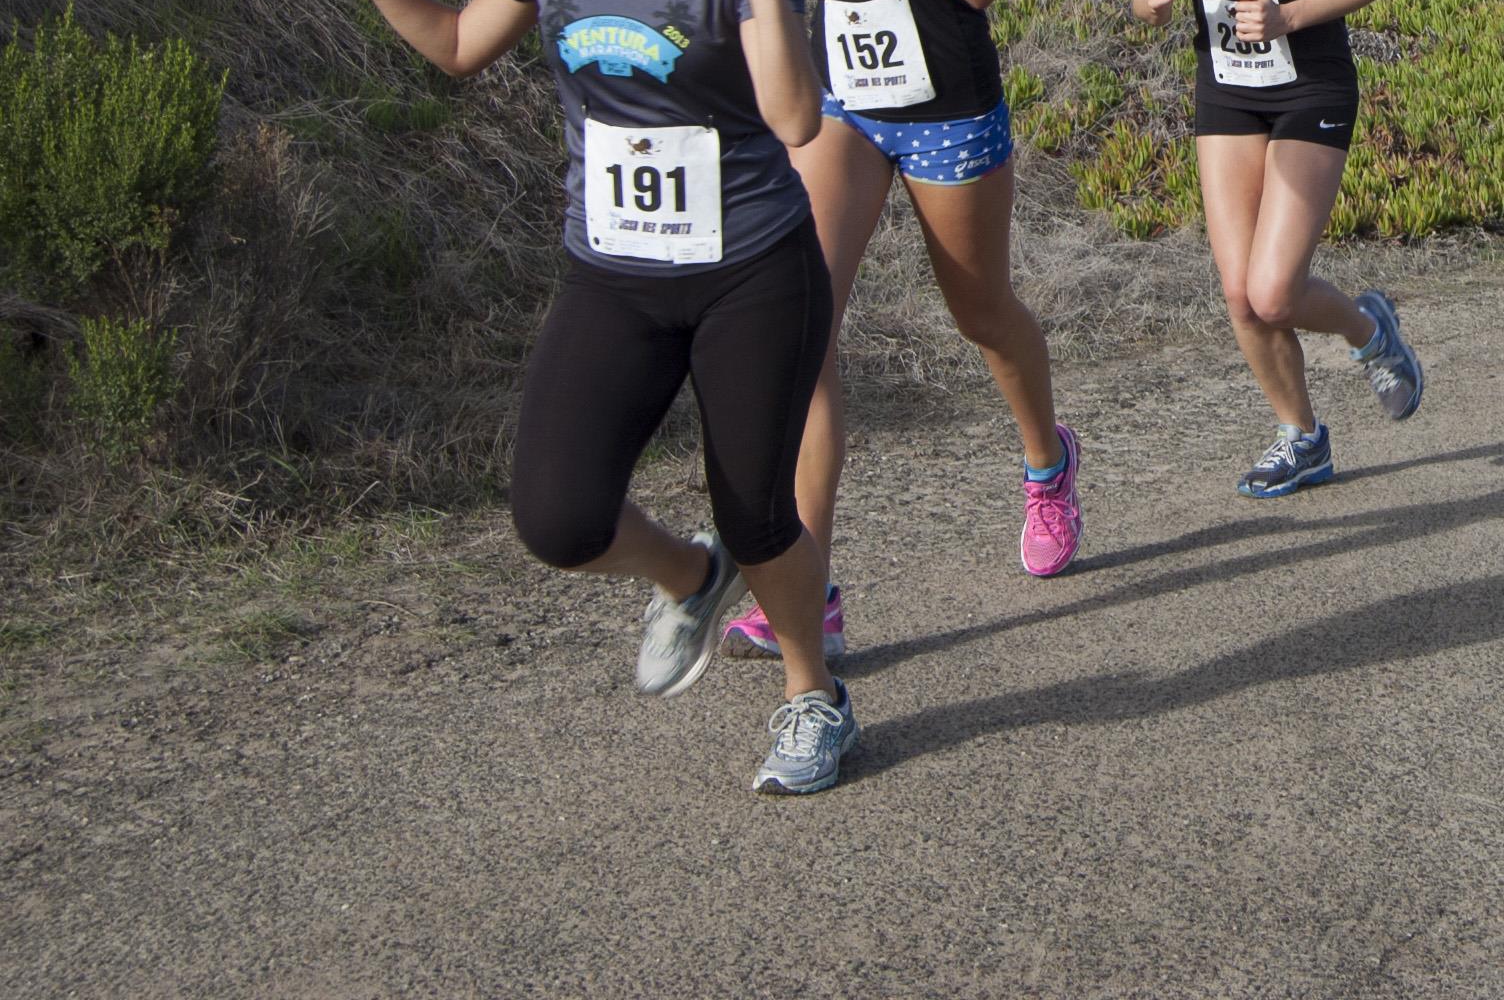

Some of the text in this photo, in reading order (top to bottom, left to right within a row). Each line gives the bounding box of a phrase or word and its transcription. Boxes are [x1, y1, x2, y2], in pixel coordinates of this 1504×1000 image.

[566, 26, 660, 61] VENTURA
[662, 25, 690, 48] 2013
[837, 30, 904, 70] 152
[884, 75, 907, 86] SPORTS
[606, 163, 687, 213] 191
[660, 223, 692, 235] SPORTS
